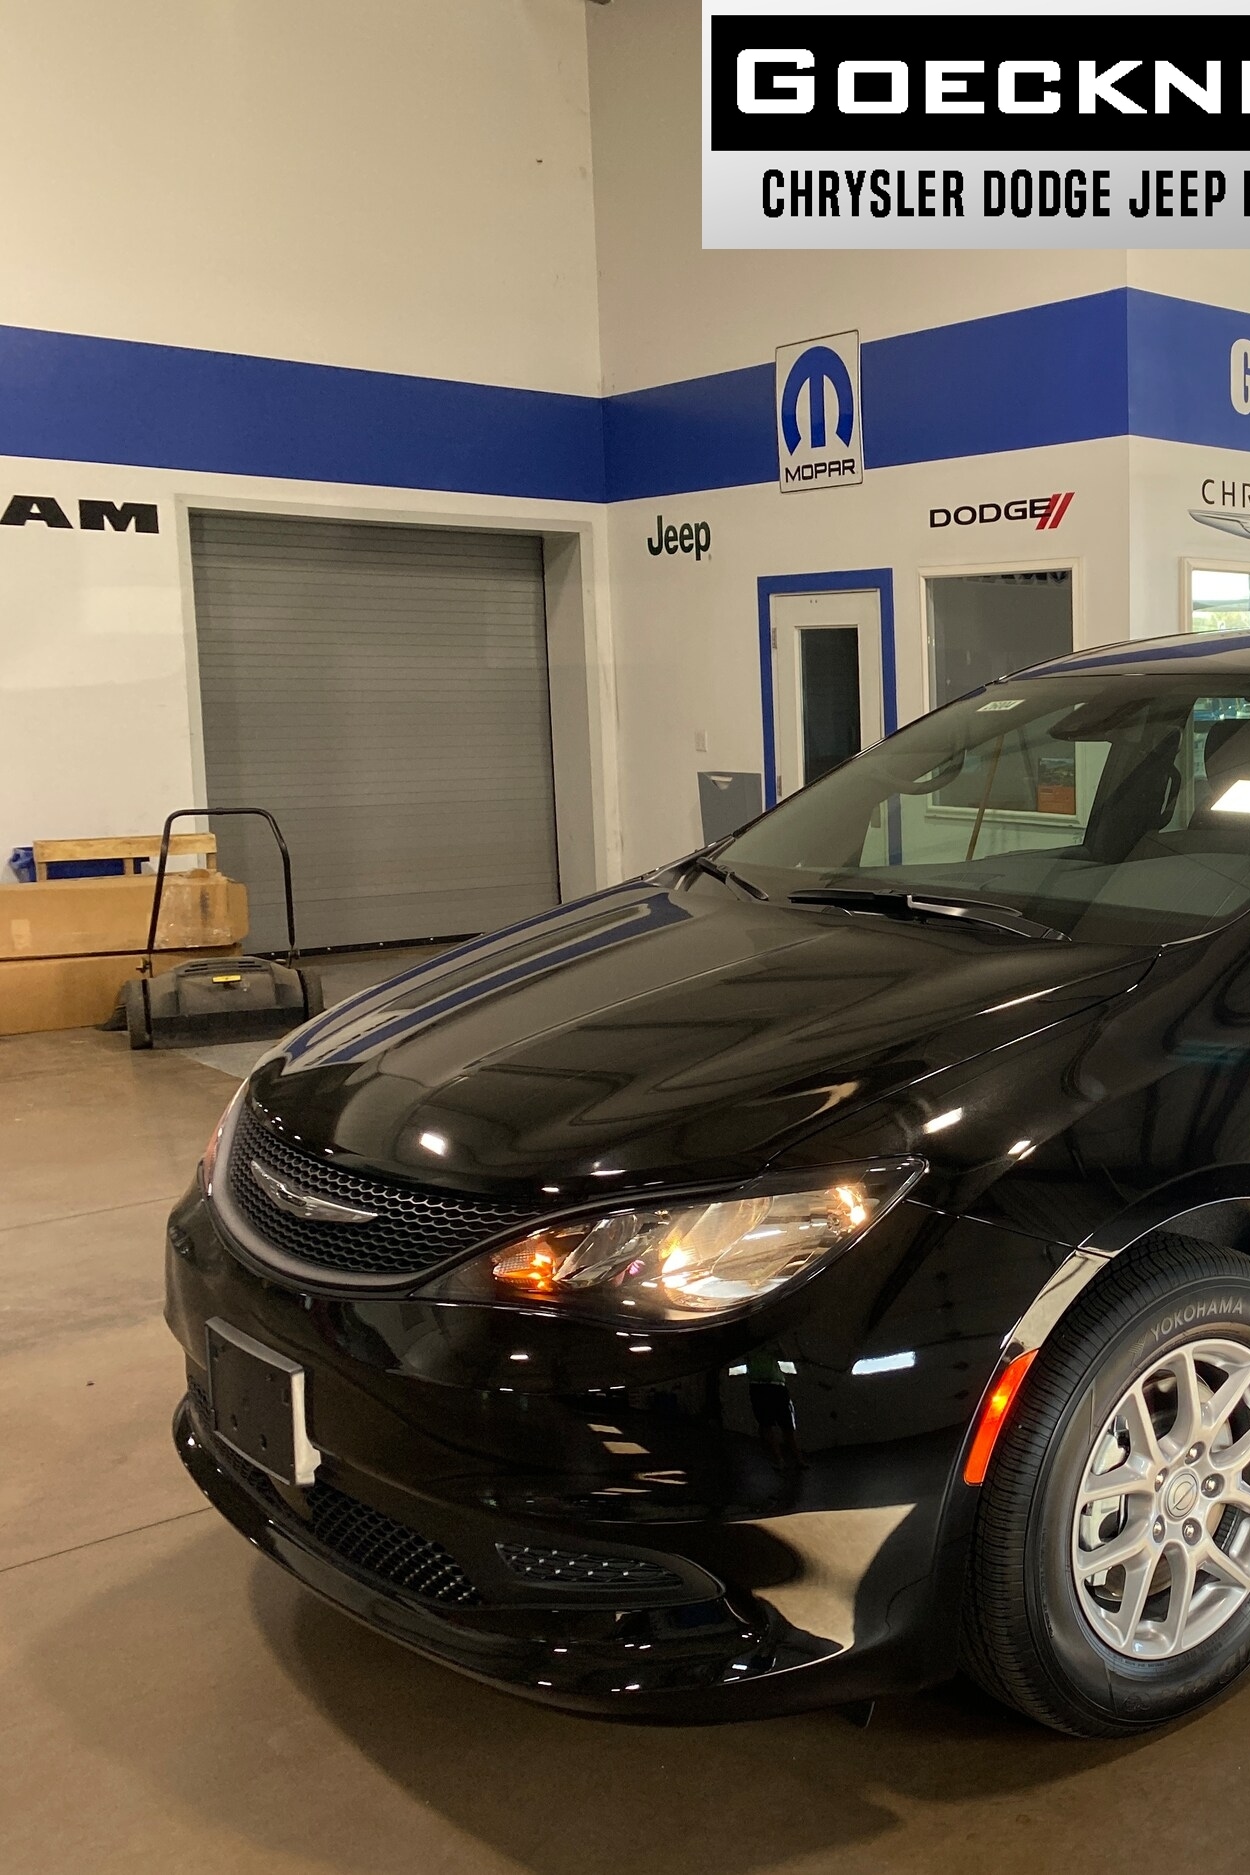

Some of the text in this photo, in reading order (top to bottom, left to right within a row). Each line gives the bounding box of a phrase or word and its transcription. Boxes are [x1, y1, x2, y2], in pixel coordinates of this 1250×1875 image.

[785, 458, 856, 484] MOPAR
[928, 496, 1058, 529] DODGE
[647, 515, 712, 561] Jeep
[1150, 1296, 1244, 1342] YOKOHAMA
